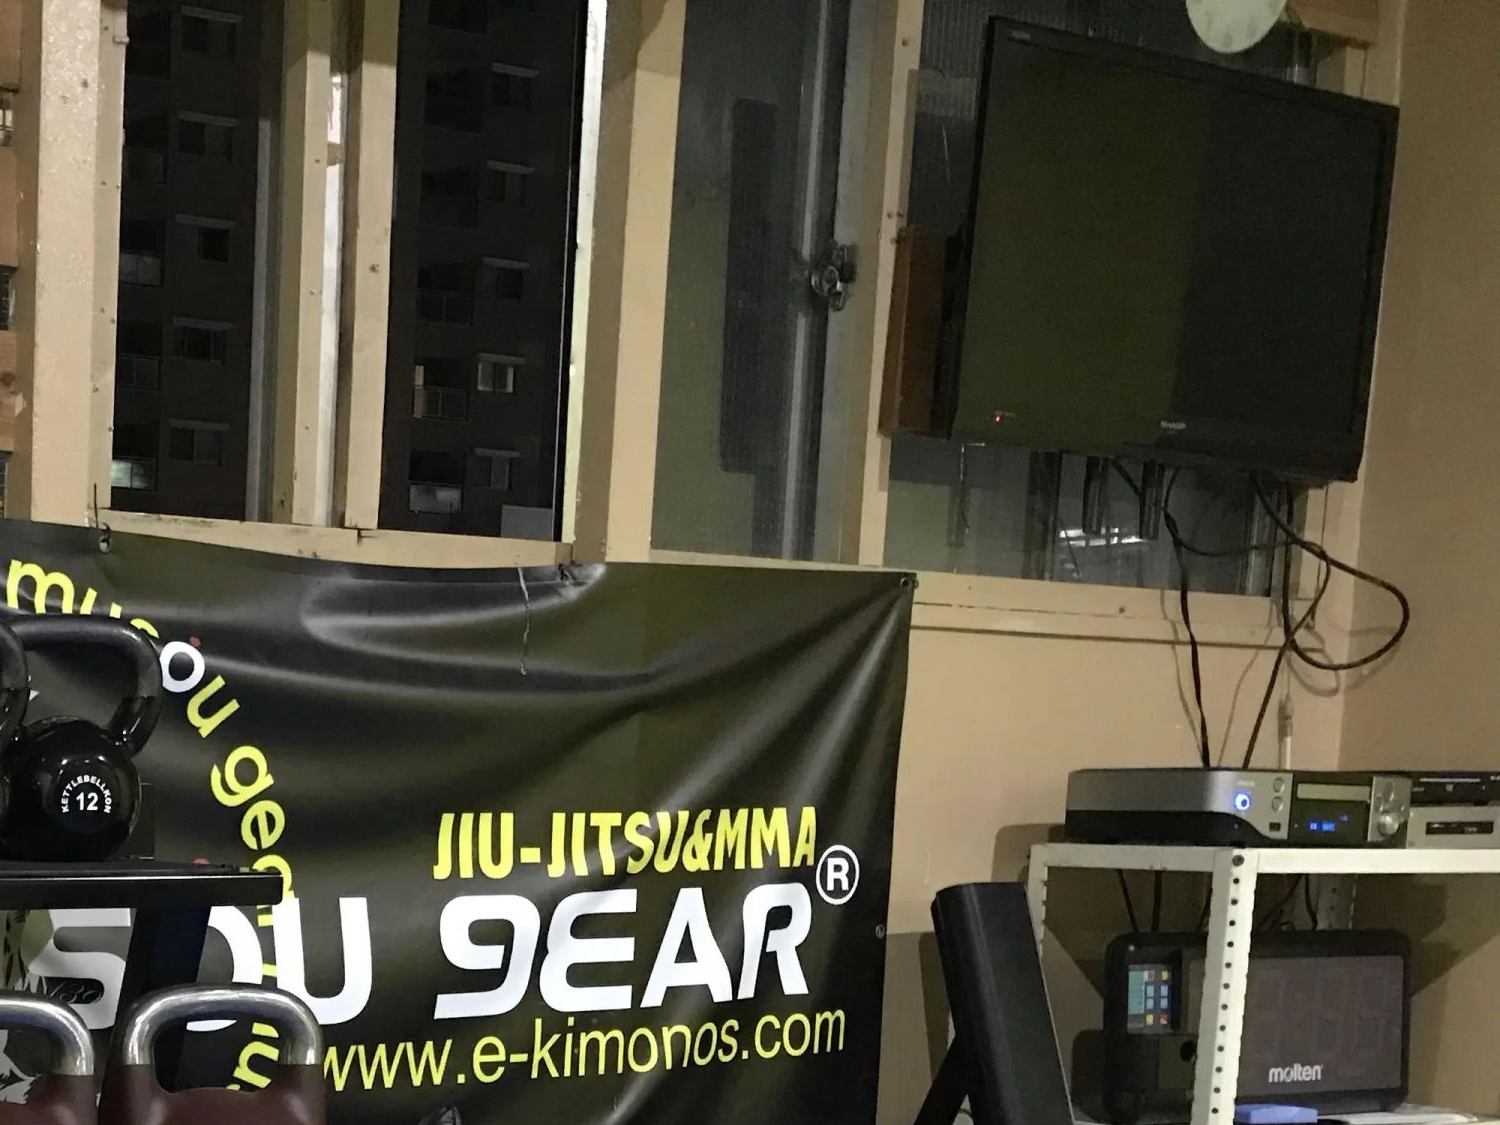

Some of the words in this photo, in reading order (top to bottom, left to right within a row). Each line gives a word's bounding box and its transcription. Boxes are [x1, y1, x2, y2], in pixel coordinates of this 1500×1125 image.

[61, 774, 112, 814] KETTLEBELLKON
[76, 792, 99, 811] 12
[432, 805, 817, 880] JIU-JITSU&MMA
[323, 1007, 846, 1092] www.e-kimonos.com
[1268, 1063, 1323, 1083] molten
